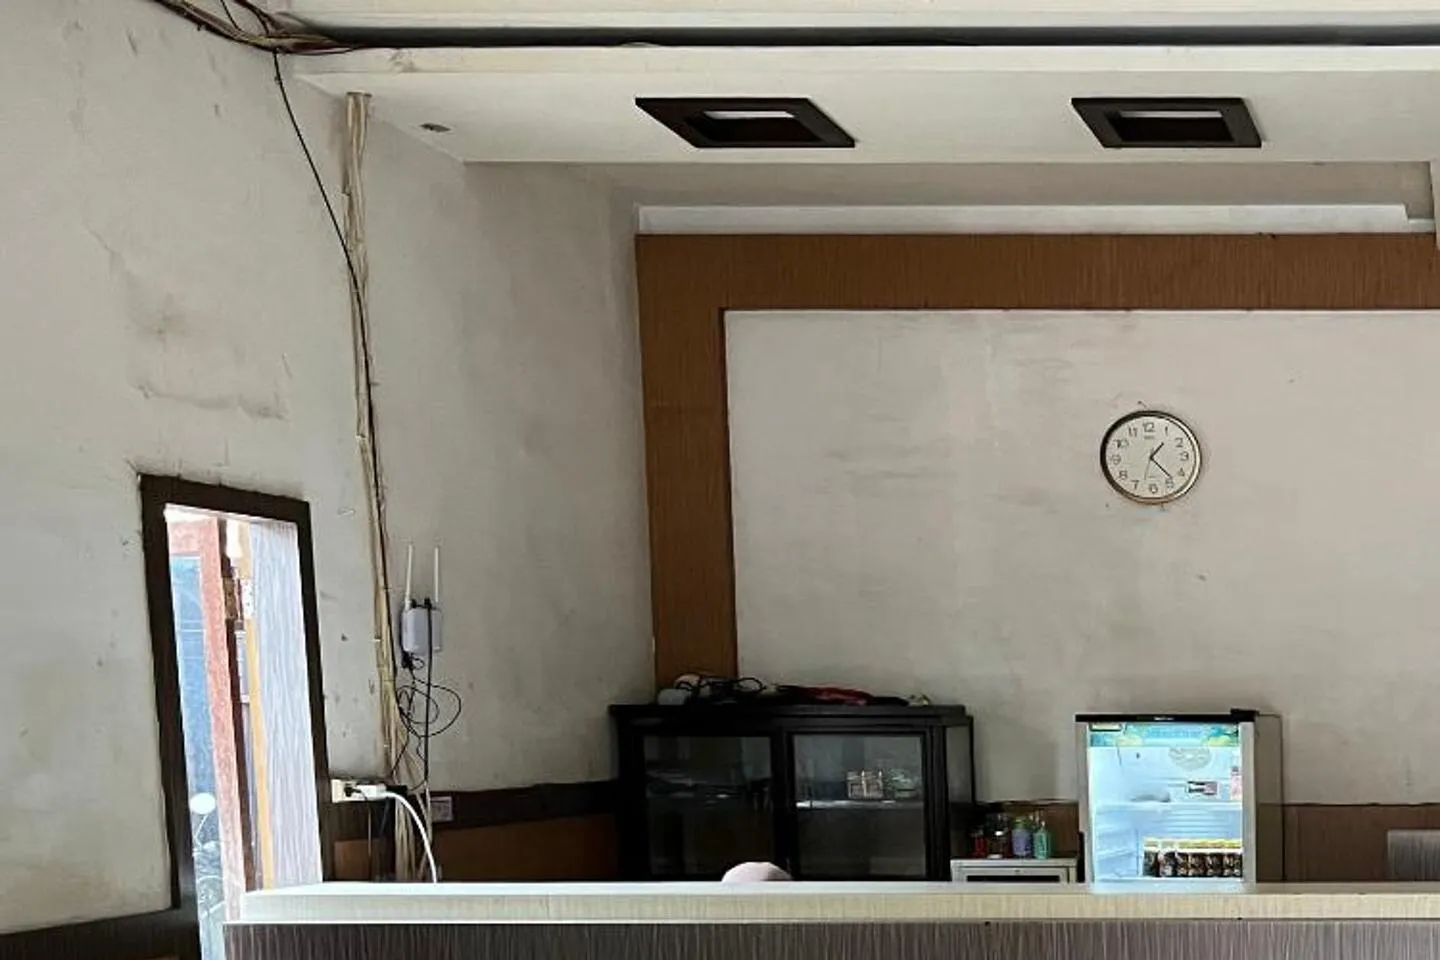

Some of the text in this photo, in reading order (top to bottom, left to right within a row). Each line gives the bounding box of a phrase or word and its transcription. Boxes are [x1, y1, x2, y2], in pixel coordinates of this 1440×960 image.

[1128, 427, 1138, 437] 11
[1143, 422, 1155, 432] 12
[1165, 426, 1169, 436] 1
[1113, 439, 1129, 449] 10
[1175, 437, 1183, 448] 2
[1180, 451, 1189, 461] 3
[1119, 470, 1128, 480] 8
[1178, 467, 1185, 477] 4
[1130, 479, 1139, 490] 7
[1148, 483, 1158, 494] 6
